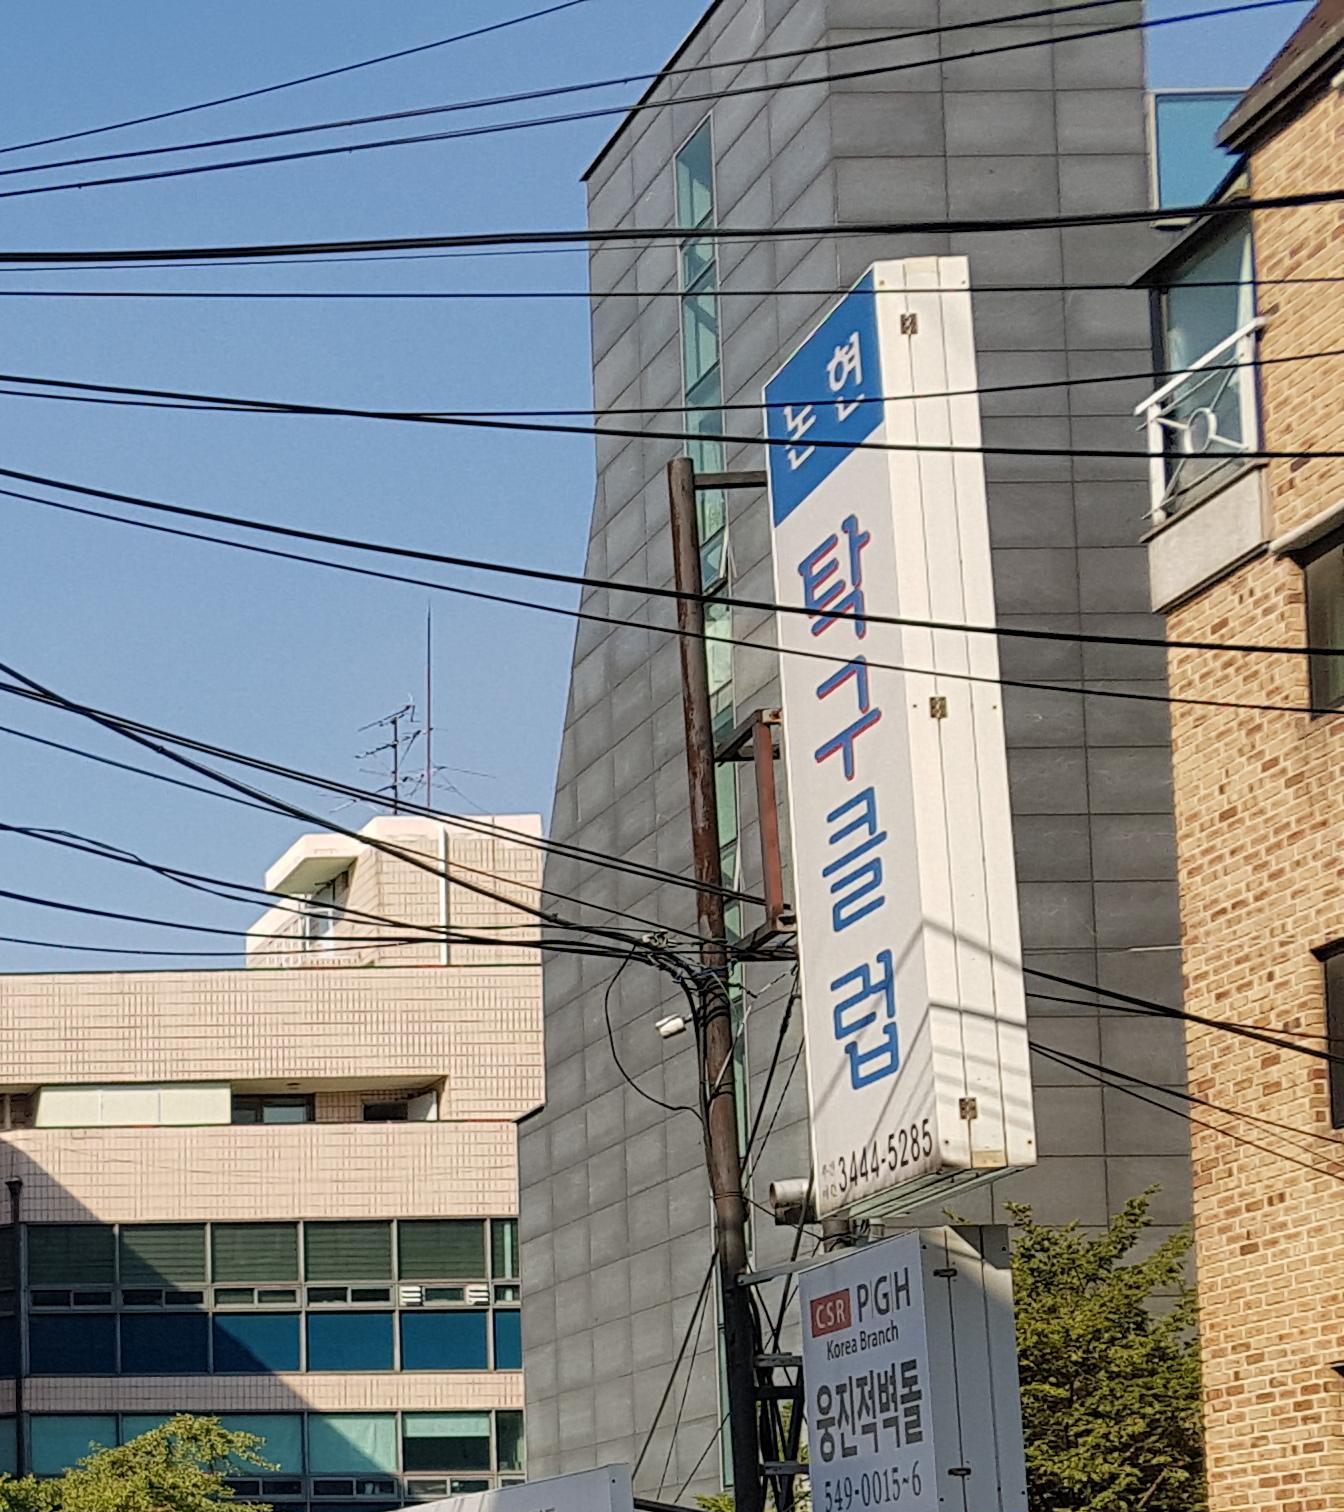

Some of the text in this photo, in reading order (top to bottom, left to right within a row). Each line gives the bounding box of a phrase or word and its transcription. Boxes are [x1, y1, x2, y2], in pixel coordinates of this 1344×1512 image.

[783, 331, 864, 470] 논현
[837, 1117, 934, 1193] 3444-5285
[815, 1300, 847, 1329] CSR
[826, 1319, 899, 1361] Korea Branch
